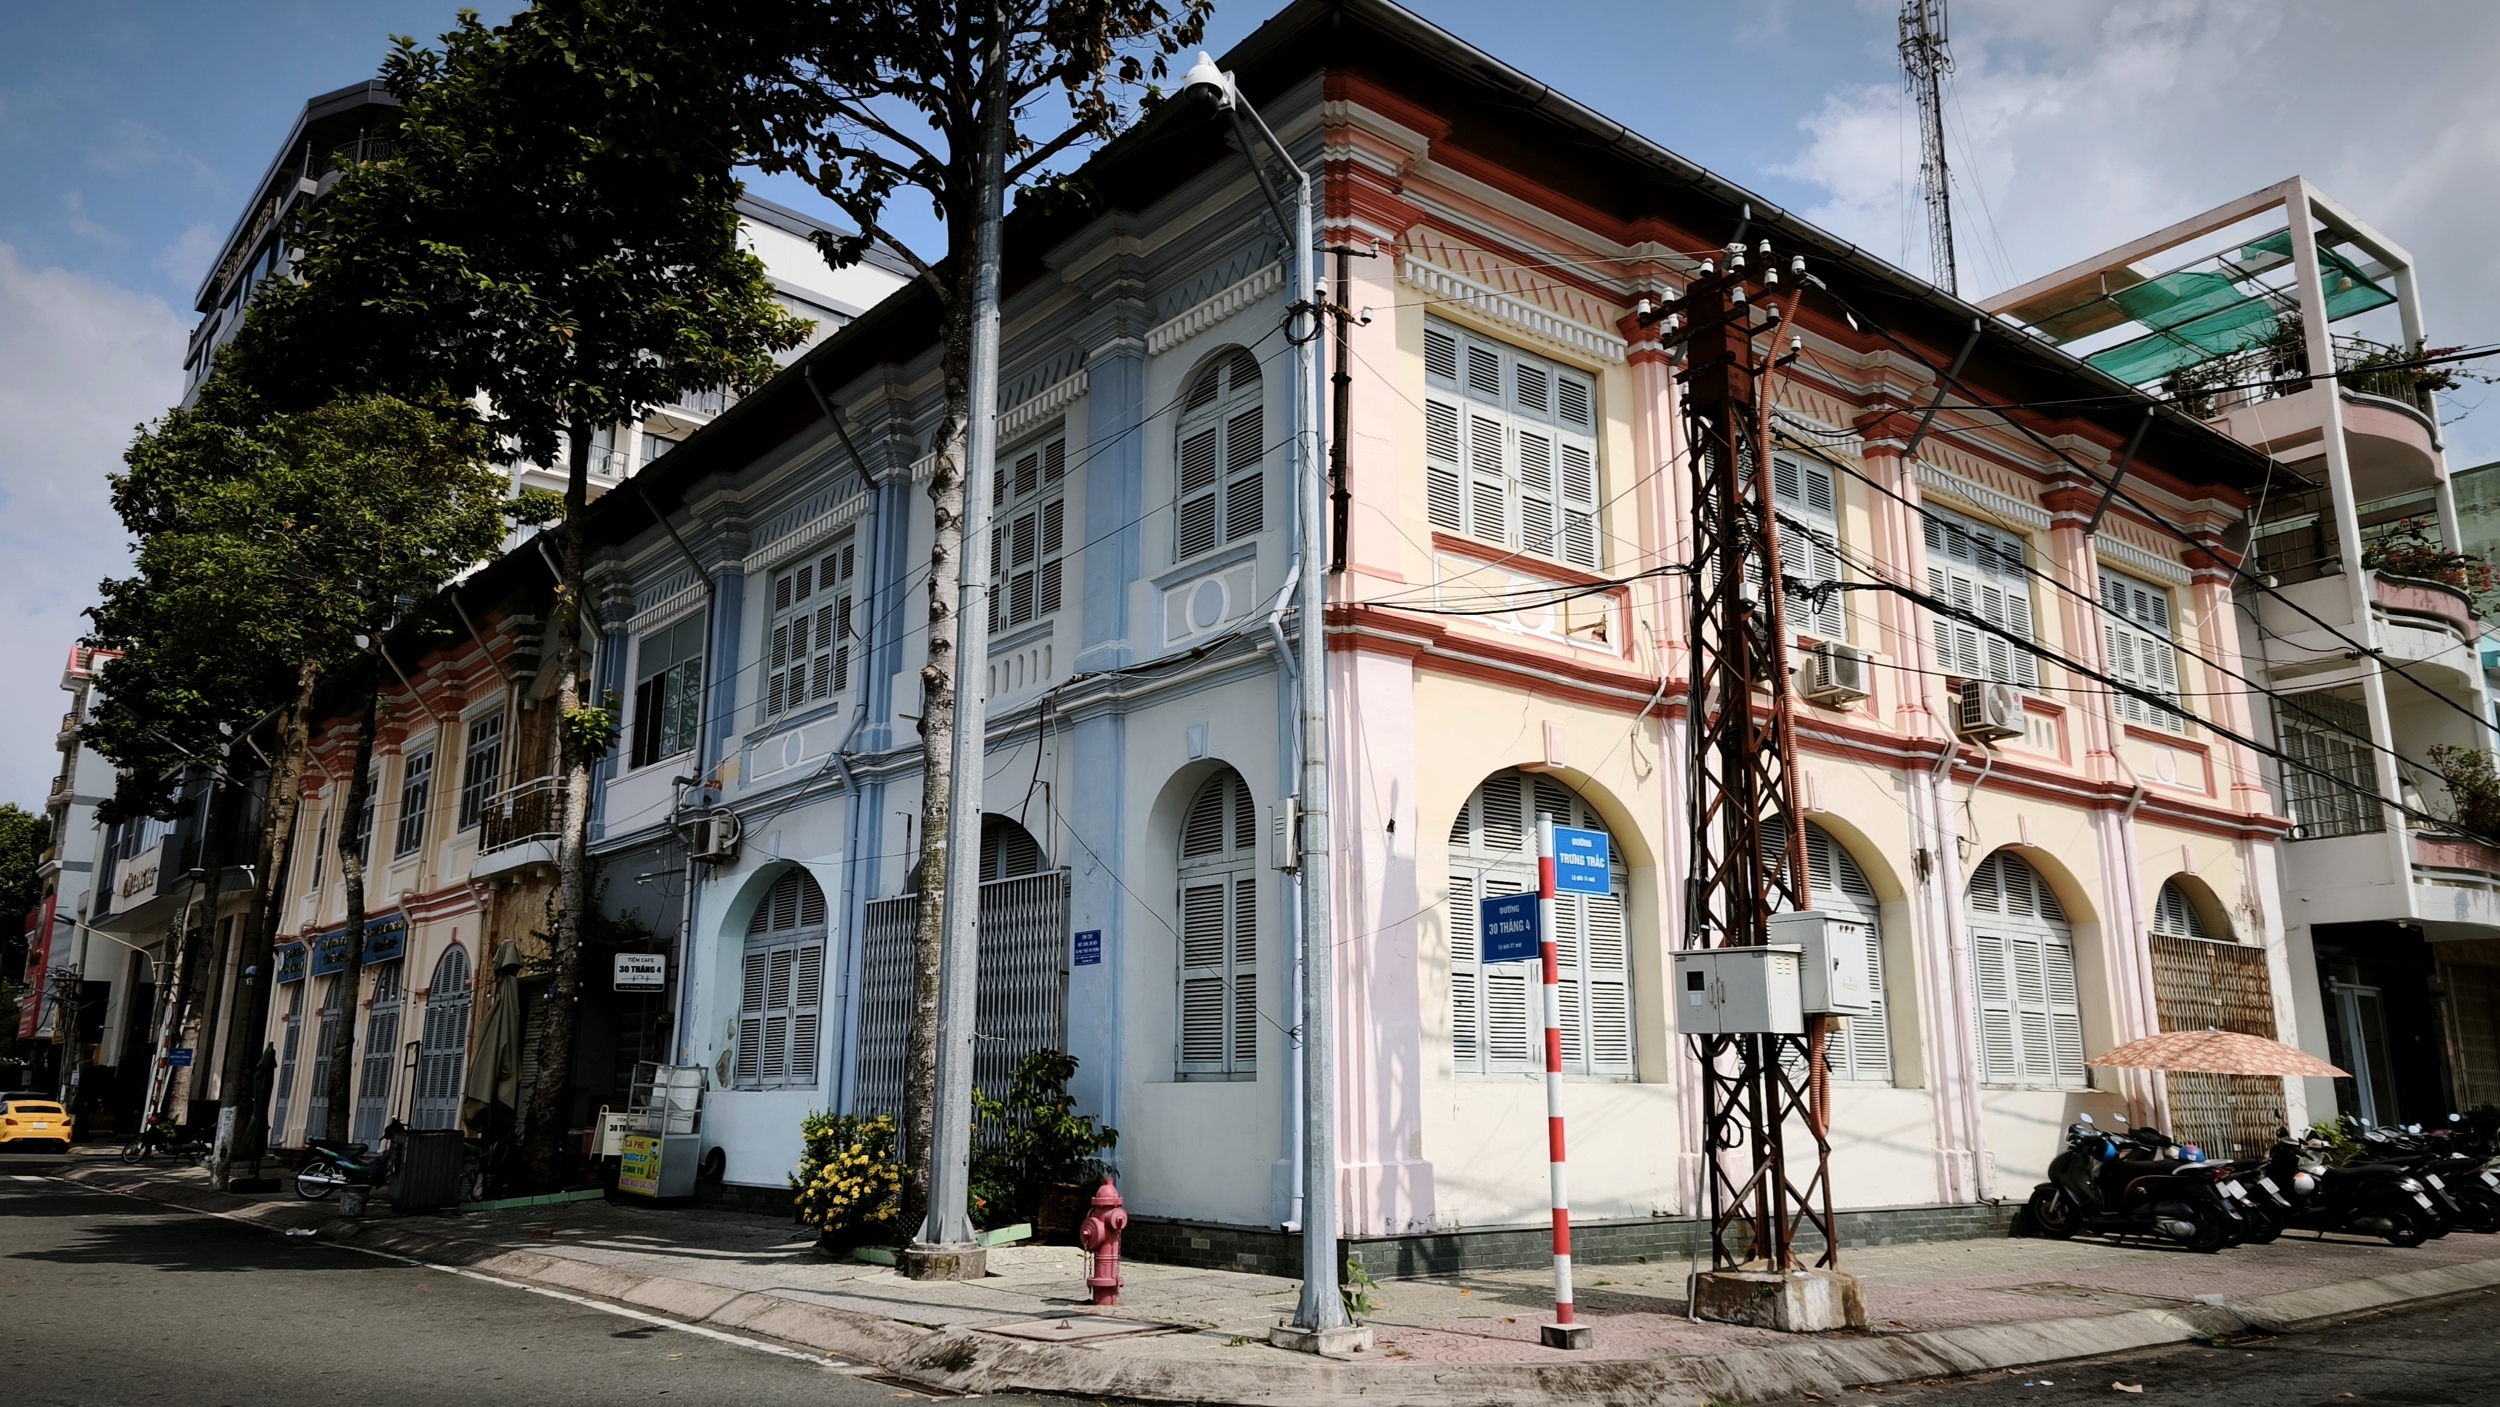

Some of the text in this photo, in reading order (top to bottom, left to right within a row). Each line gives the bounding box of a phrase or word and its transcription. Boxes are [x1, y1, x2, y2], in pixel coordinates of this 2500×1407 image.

[1559, 852, 1605, 868] TRƯNG TRẮC
[1499, 904, 1520, 915] ĐƯỜNG
[1489, 918, 1531, 935] 30 THÁNG 4
[619, 965, 630, 973] 30
[631, 964, 655, 974] THÁNG
[622, 1165, 636, 1174] SINH
